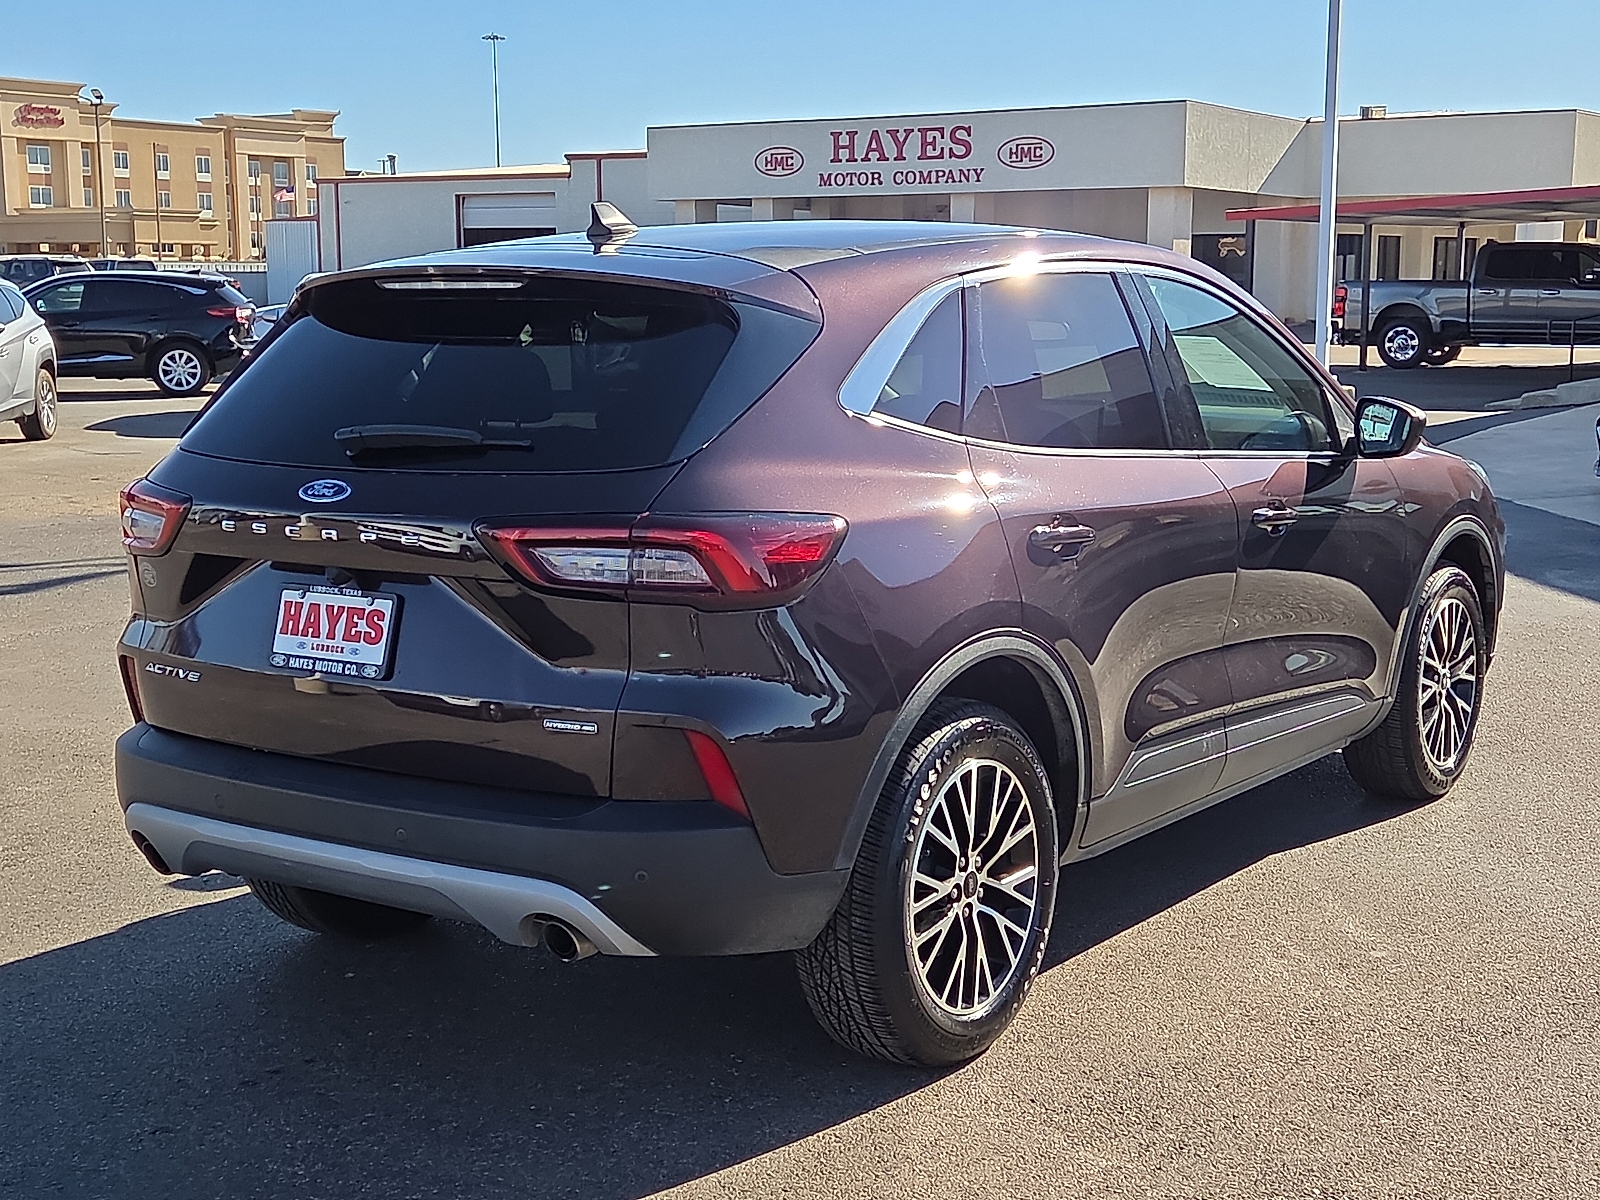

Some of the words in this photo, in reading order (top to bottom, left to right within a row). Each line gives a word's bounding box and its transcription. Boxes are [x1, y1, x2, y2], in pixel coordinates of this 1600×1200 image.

[830, 125, 973, 163] HAYES
[1008, 142, 1044, 164] HMC
[763, 151, 795, 172] HMC
[818, 171, 884, 187] MOTOR
[893, 167, 985, 186] COMPANY
[221, 519, 420, 547] ESCAPE
[279, 600, 386, 646] HAYES
[145, 662, 202, 682] ACTIVE
[288, 657, 315, 670] HAYES
[315, 660, 343, 674] MOTOR
[344, 664, 359, 676] CO.
